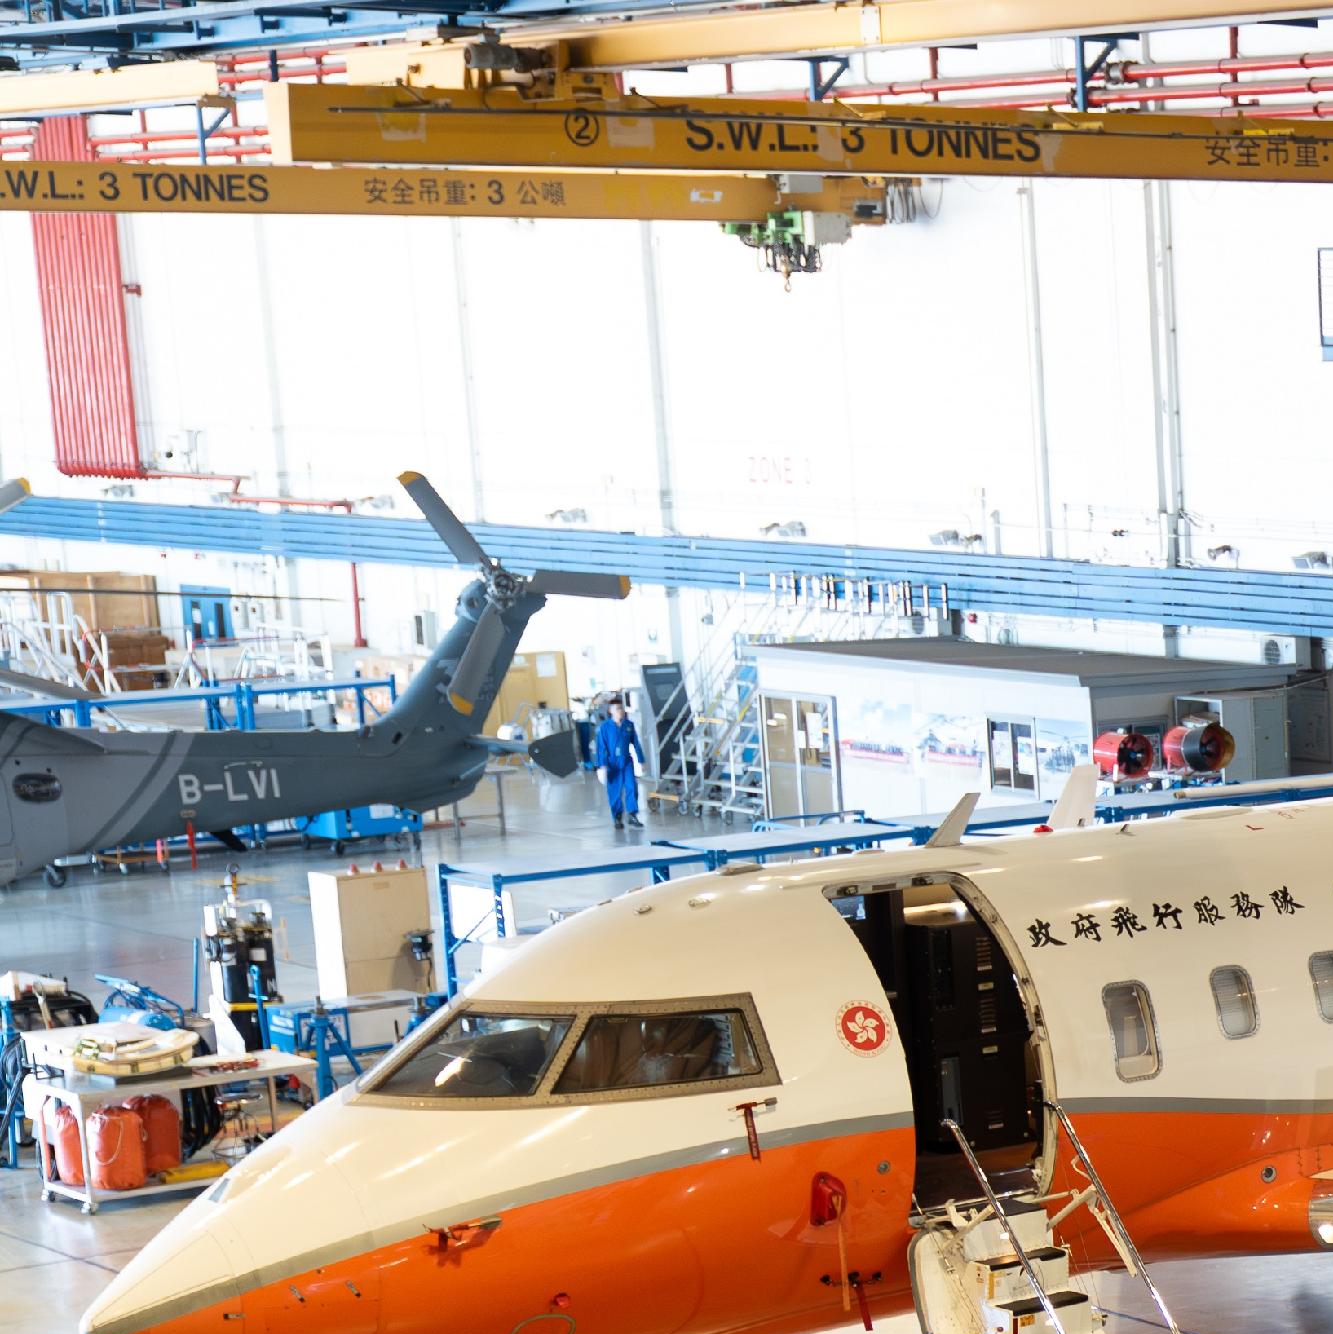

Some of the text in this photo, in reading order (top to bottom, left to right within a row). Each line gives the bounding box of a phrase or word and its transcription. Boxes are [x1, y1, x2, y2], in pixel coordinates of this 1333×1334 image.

[841, 117, 866, 154] 3
[889, 118, 1042, 163] TONNES
[0, 170, 270, 203] .W.L.: 3 TONNES
[487, 179, 505, 206] 3
[178, 767, 281, 805] B-LVI
[1026, 885, 1306, 948] 政府飛行服務隊
